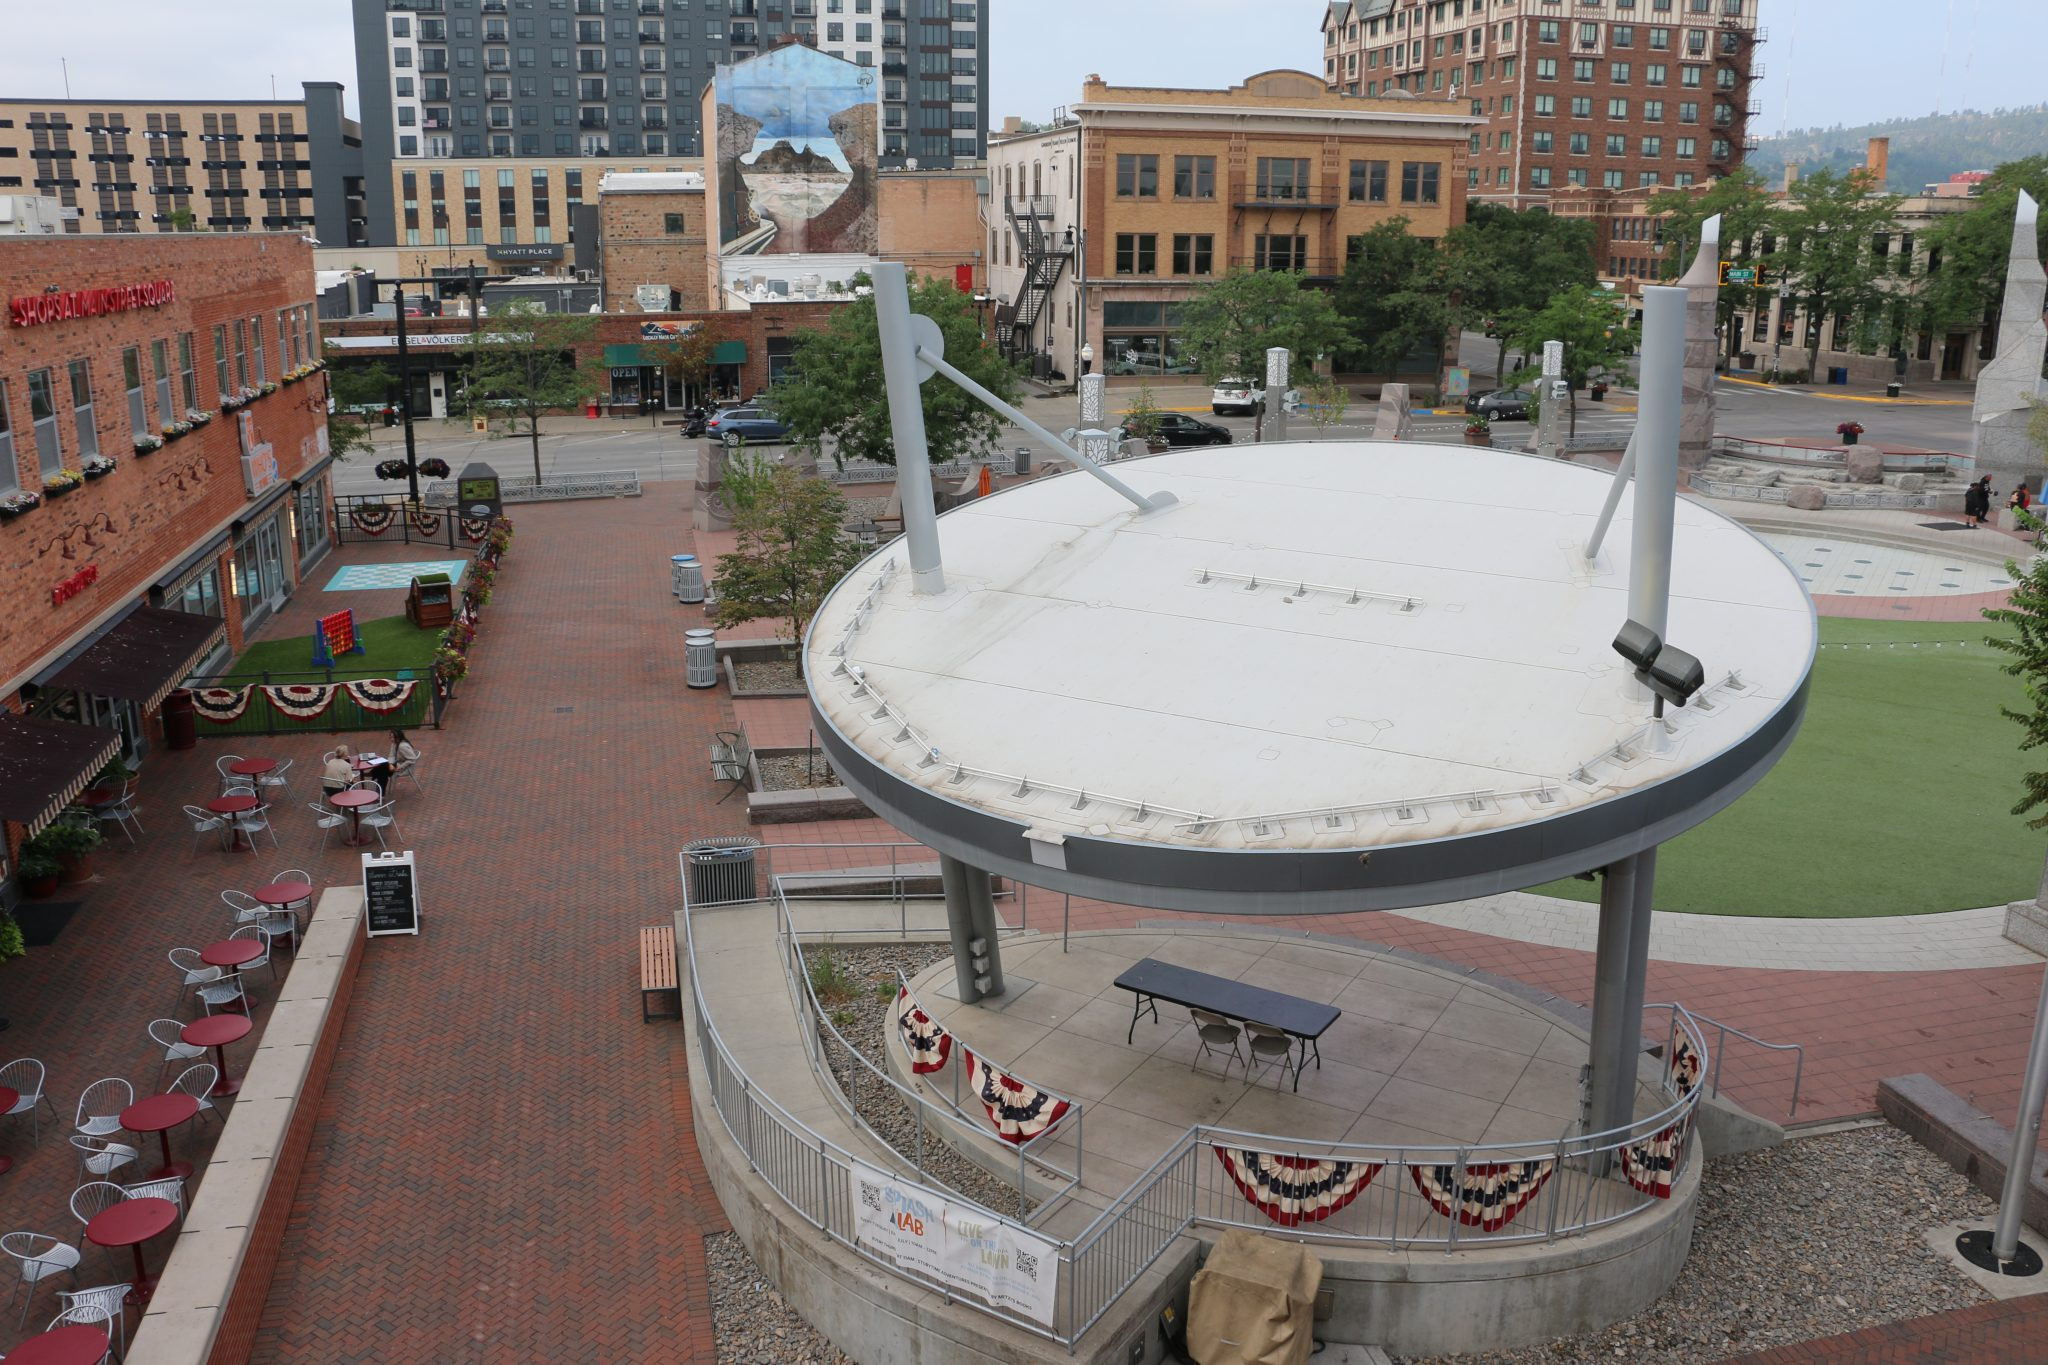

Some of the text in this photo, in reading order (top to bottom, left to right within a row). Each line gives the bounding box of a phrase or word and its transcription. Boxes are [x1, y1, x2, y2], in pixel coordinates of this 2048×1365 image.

[18, 294, 62, 327] SHOPS
[81, 290, 108, 317] MAIN
[109, 284, 141, 313] STREET
[142, 280, 175, 307] SQUARE
[612, 367, 638, 378] OPEN
[884, 1185, 935, 1223] SPLASH
[897, 1211, 924, 1237] LAB
[957, 1219, 983, 1239] LIVE
[970, 1238, 982, 1249] ON
[981, 1248, 1009, 1270] LAWN
